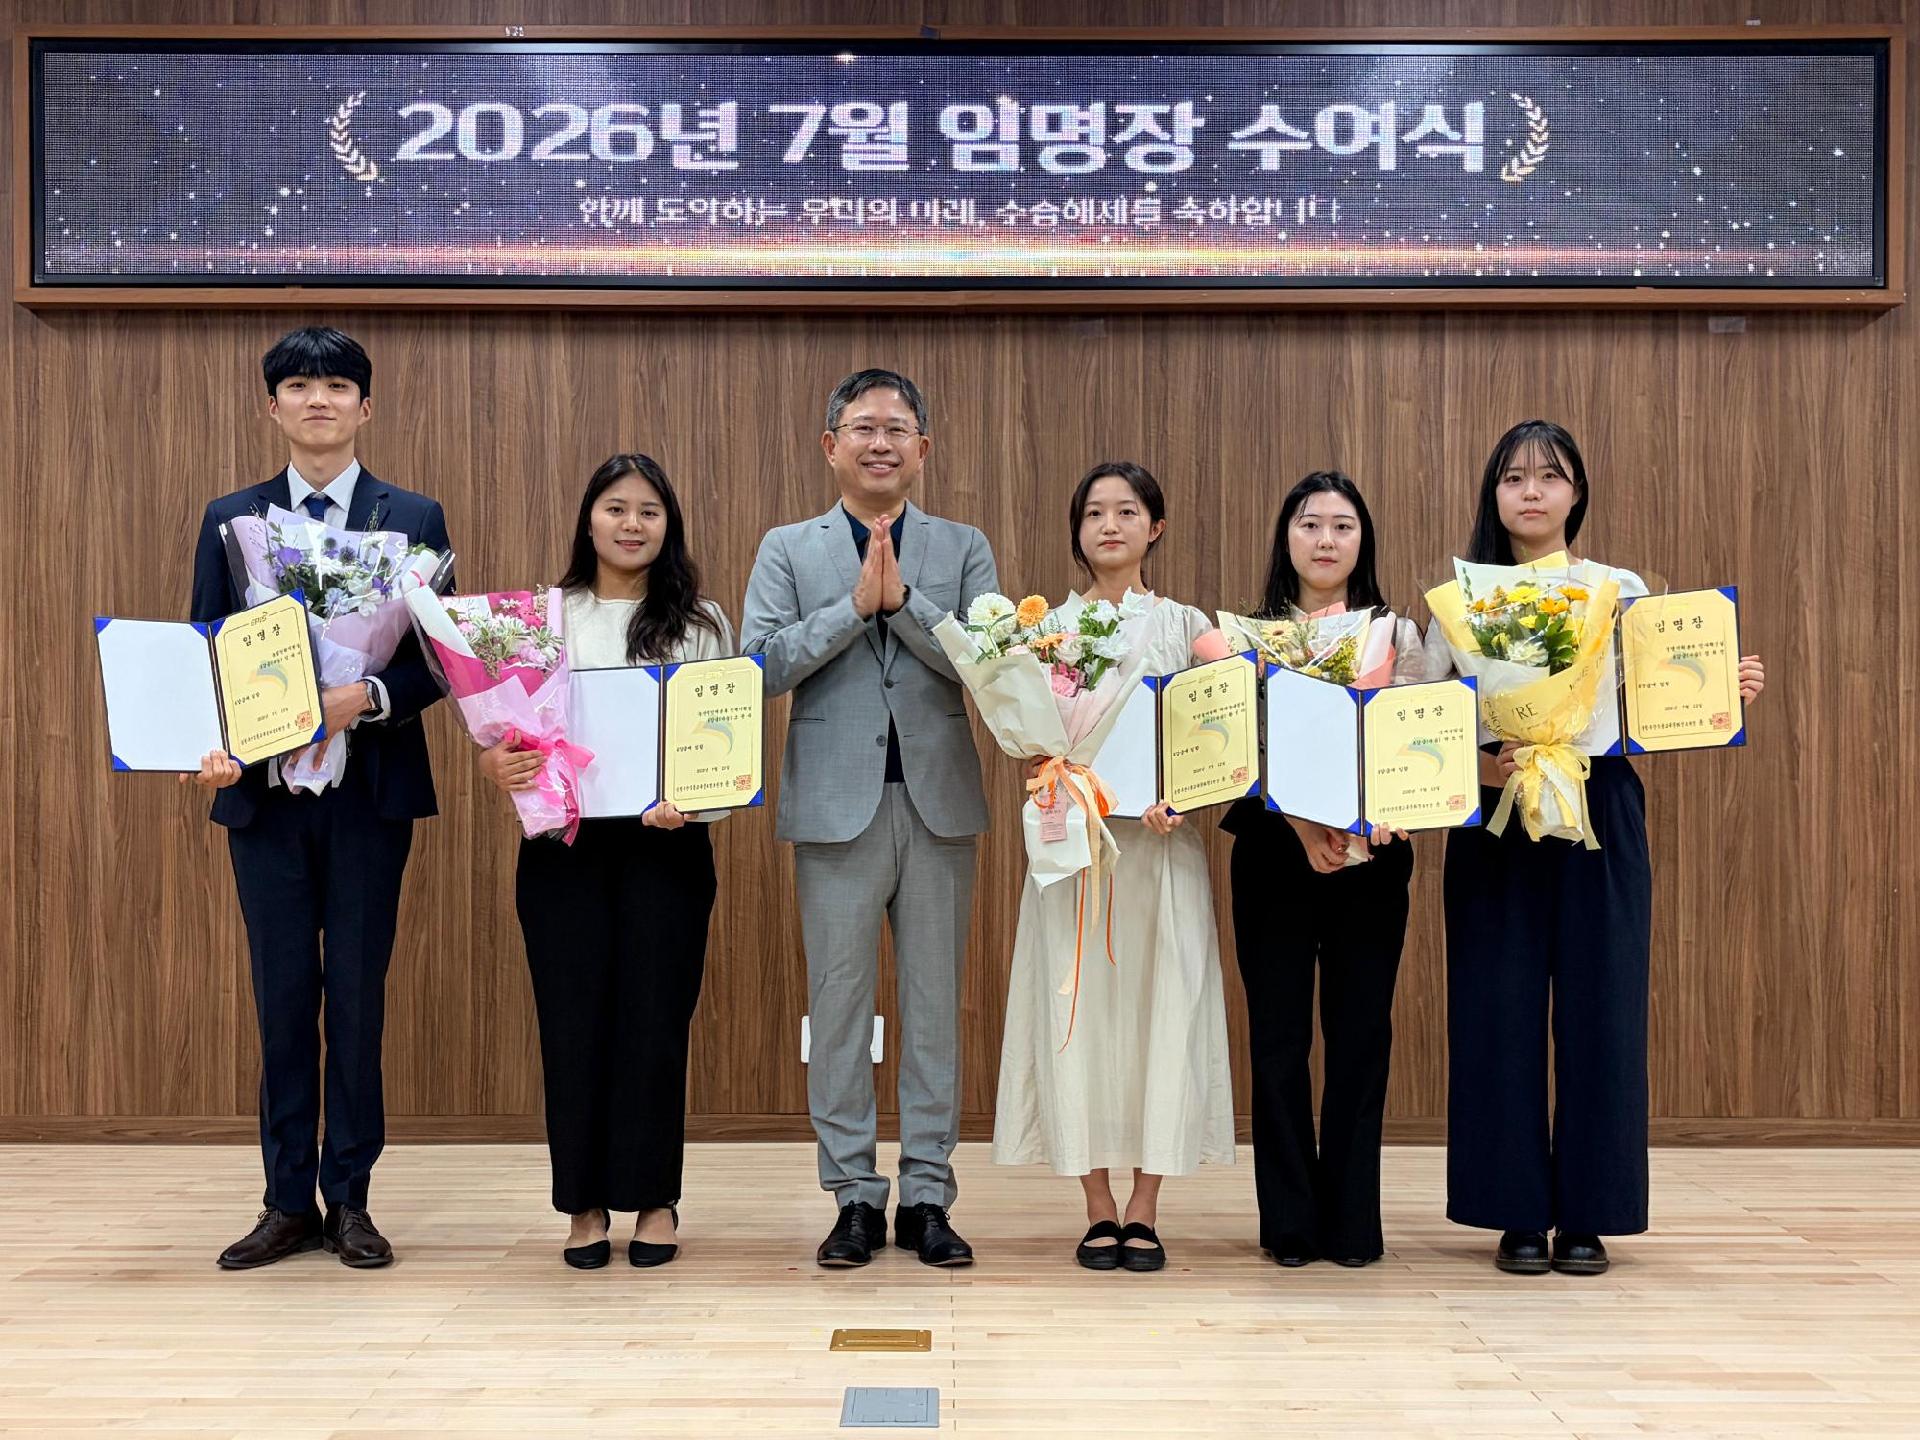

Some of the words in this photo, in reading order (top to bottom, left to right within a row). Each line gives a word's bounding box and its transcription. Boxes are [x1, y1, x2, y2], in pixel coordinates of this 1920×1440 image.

[396, 101, 740, 170] 2026년
[769, 101, 909, 171] 7월
[937, 98, 1204, 173] 임명장
[1228, 100, 1485, 172] 수여식
